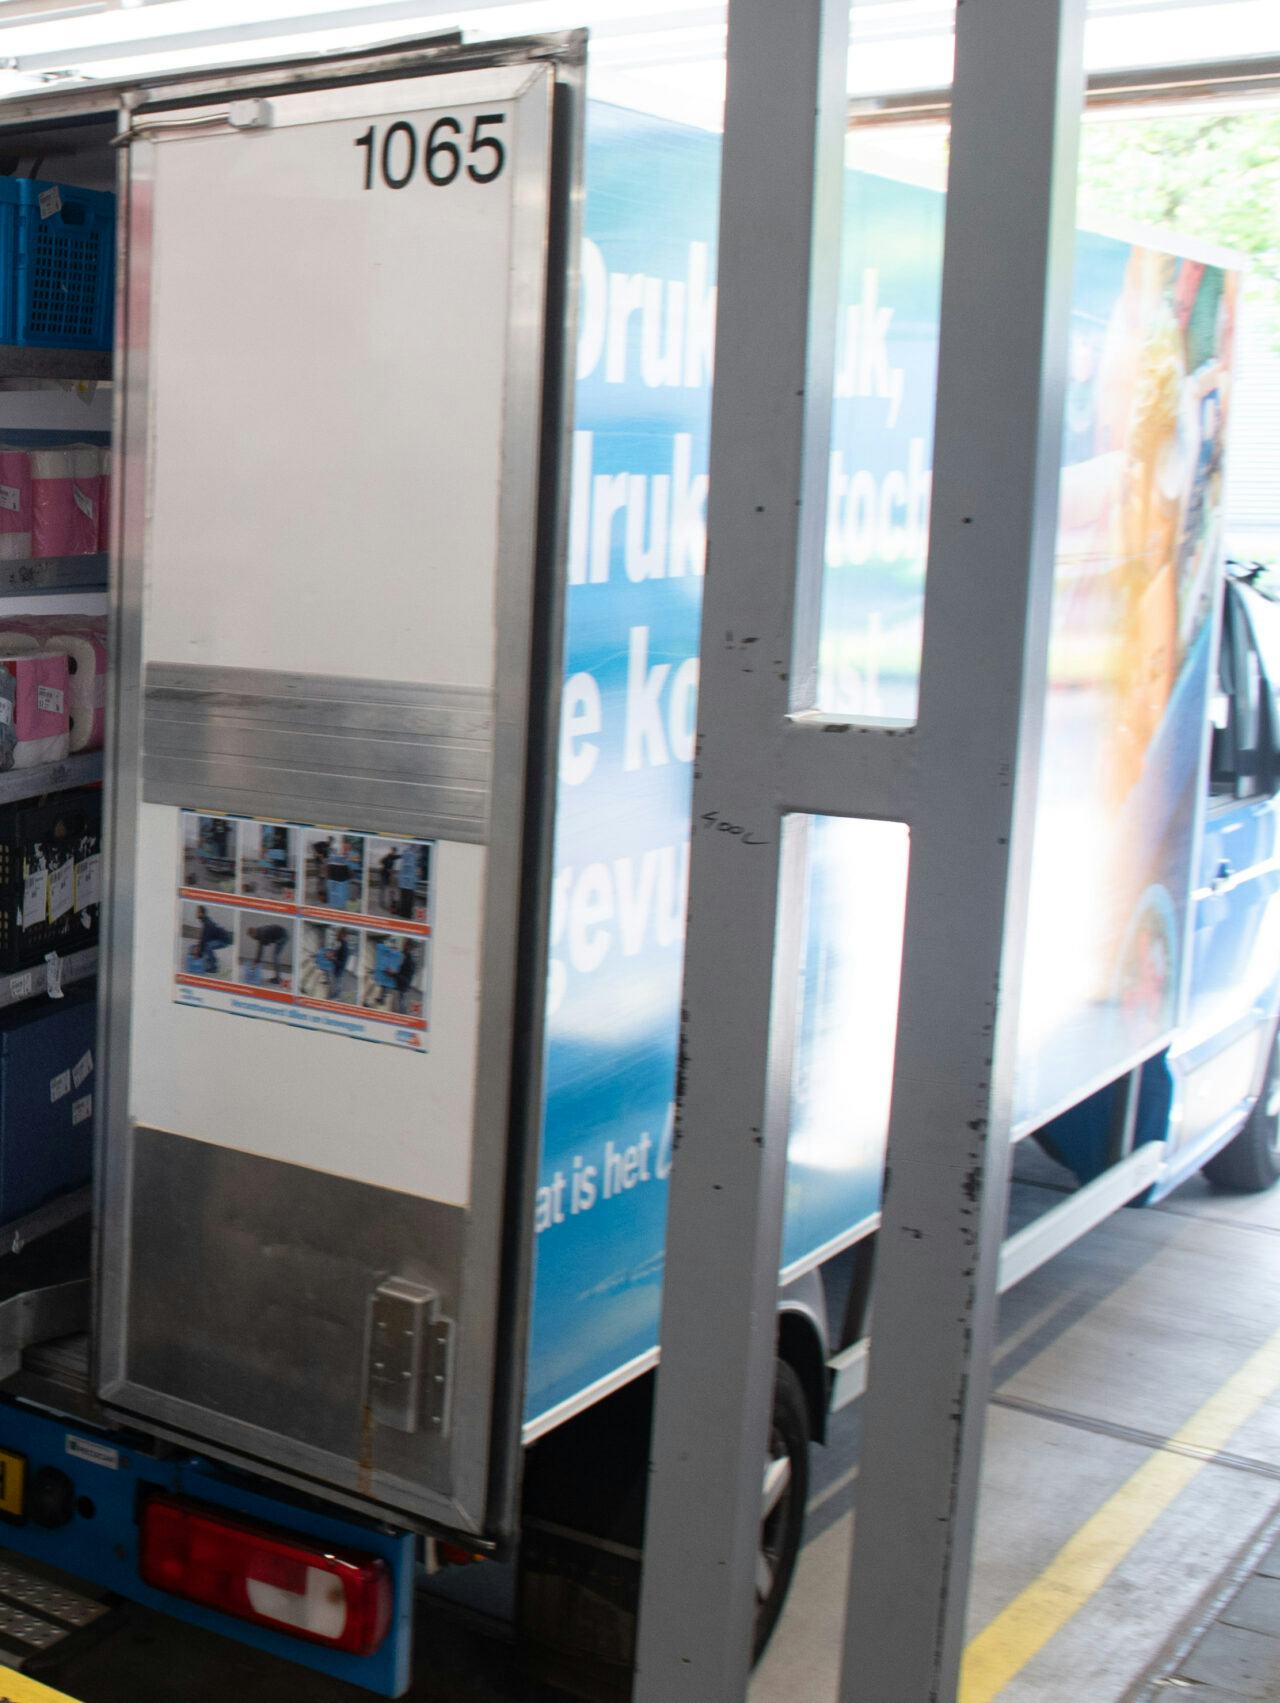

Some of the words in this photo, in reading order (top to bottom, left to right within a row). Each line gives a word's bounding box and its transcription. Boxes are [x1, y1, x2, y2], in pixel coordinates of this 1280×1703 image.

[355, 113, 505, 190] 1065
[571, 1157, 597, 1214] is
[604, 1132, 652, 1199] het
